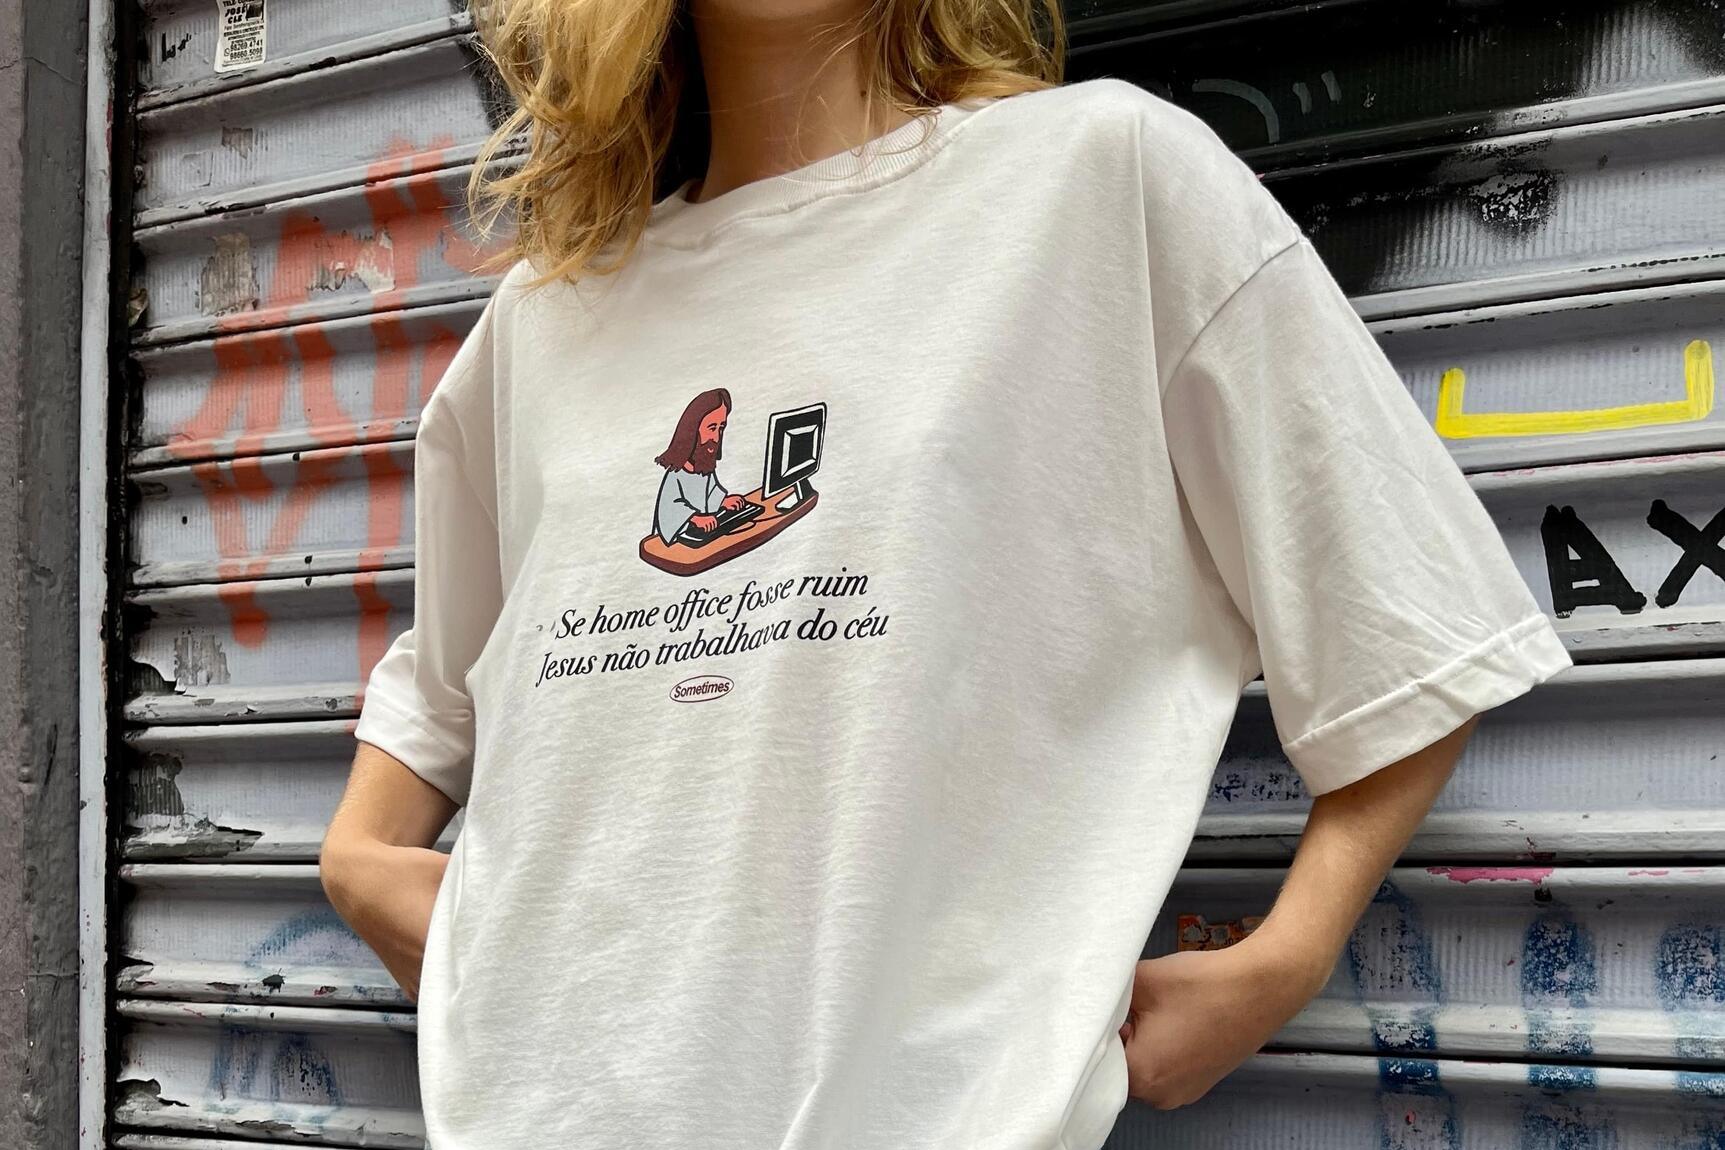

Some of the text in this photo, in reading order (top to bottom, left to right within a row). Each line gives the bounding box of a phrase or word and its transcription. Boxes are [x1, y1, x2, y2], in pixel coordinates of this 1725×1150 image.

[555, 566, 869, 640] Se home office fosse ruim
[535, 606, 890, 688] Jesus não trabalhava do céu
[673, 680, 730, 699] Sometimes
